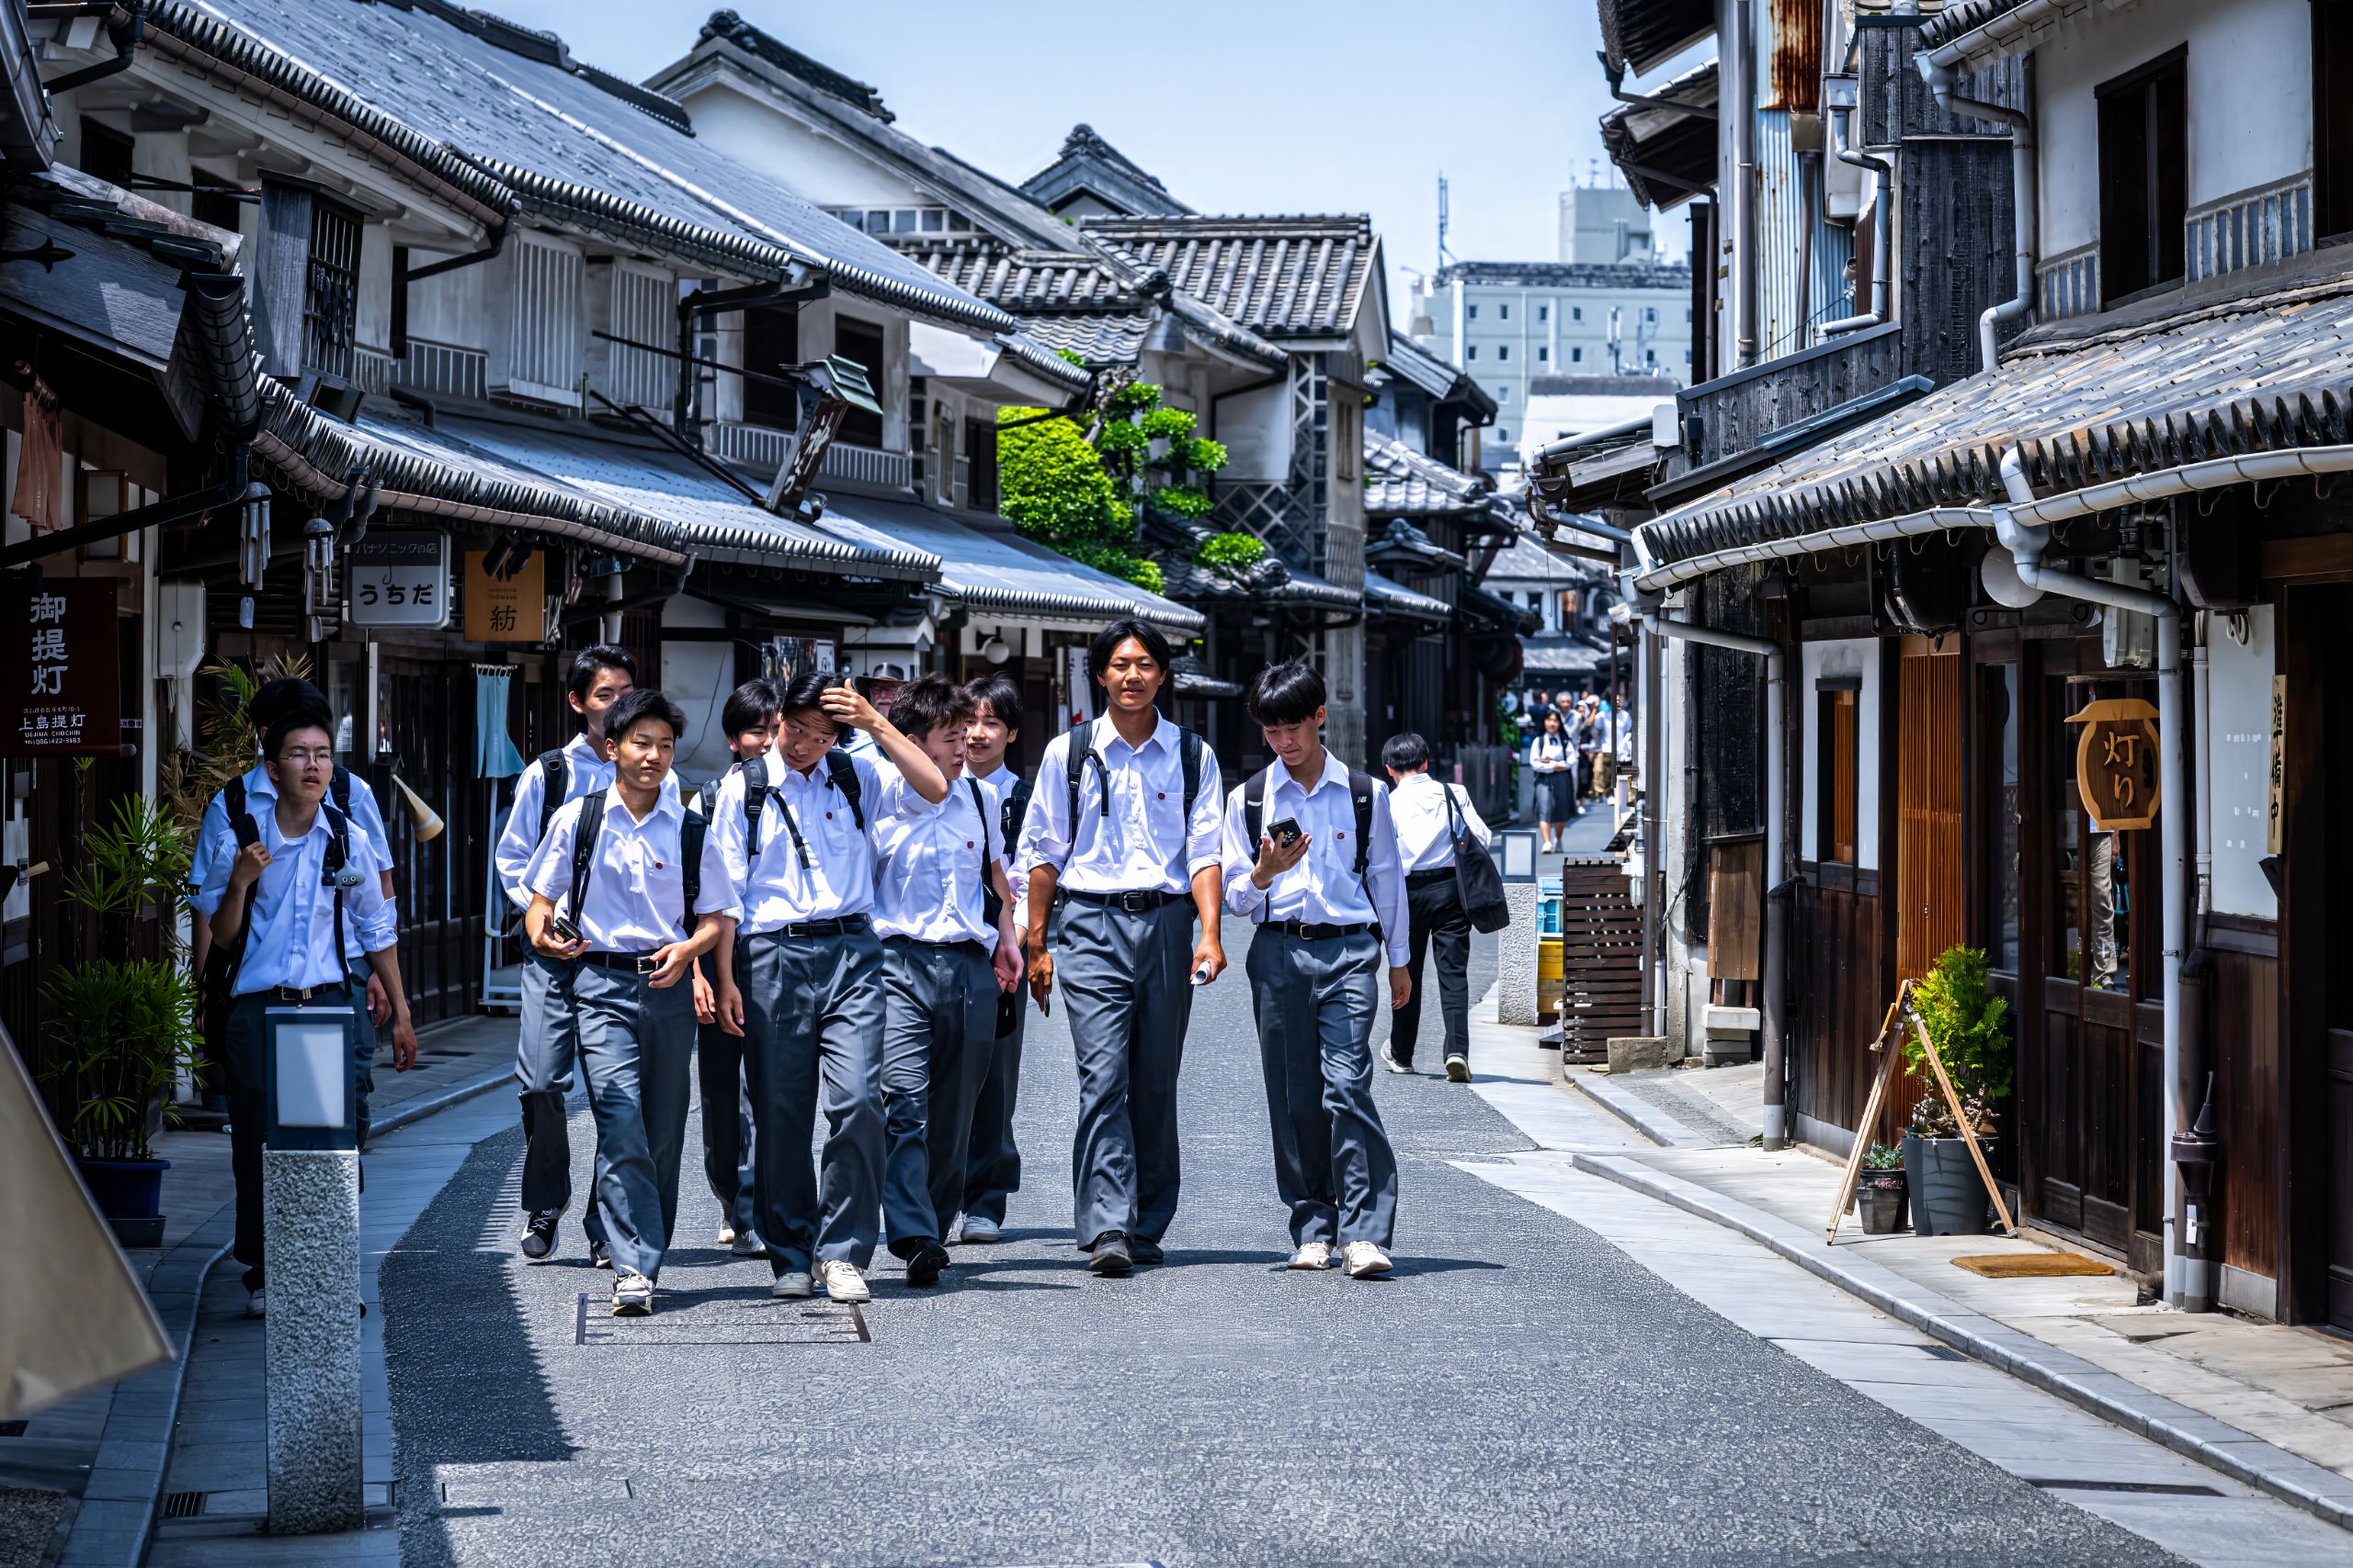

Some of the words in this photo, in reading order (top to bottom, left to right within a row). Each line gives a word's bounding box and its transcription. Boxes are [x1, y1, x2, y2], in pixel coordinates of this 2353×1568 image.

[359, 584, 433, 605] うちだ
[490, 605, 517, 631] 紡
[29, 592, 69, 695] 御提灯
[18, 713, 86, 732] 上島提灯
[2103, 731, 2141, 809] 灯り
[2270, 693, 2283, 839] 準備中
